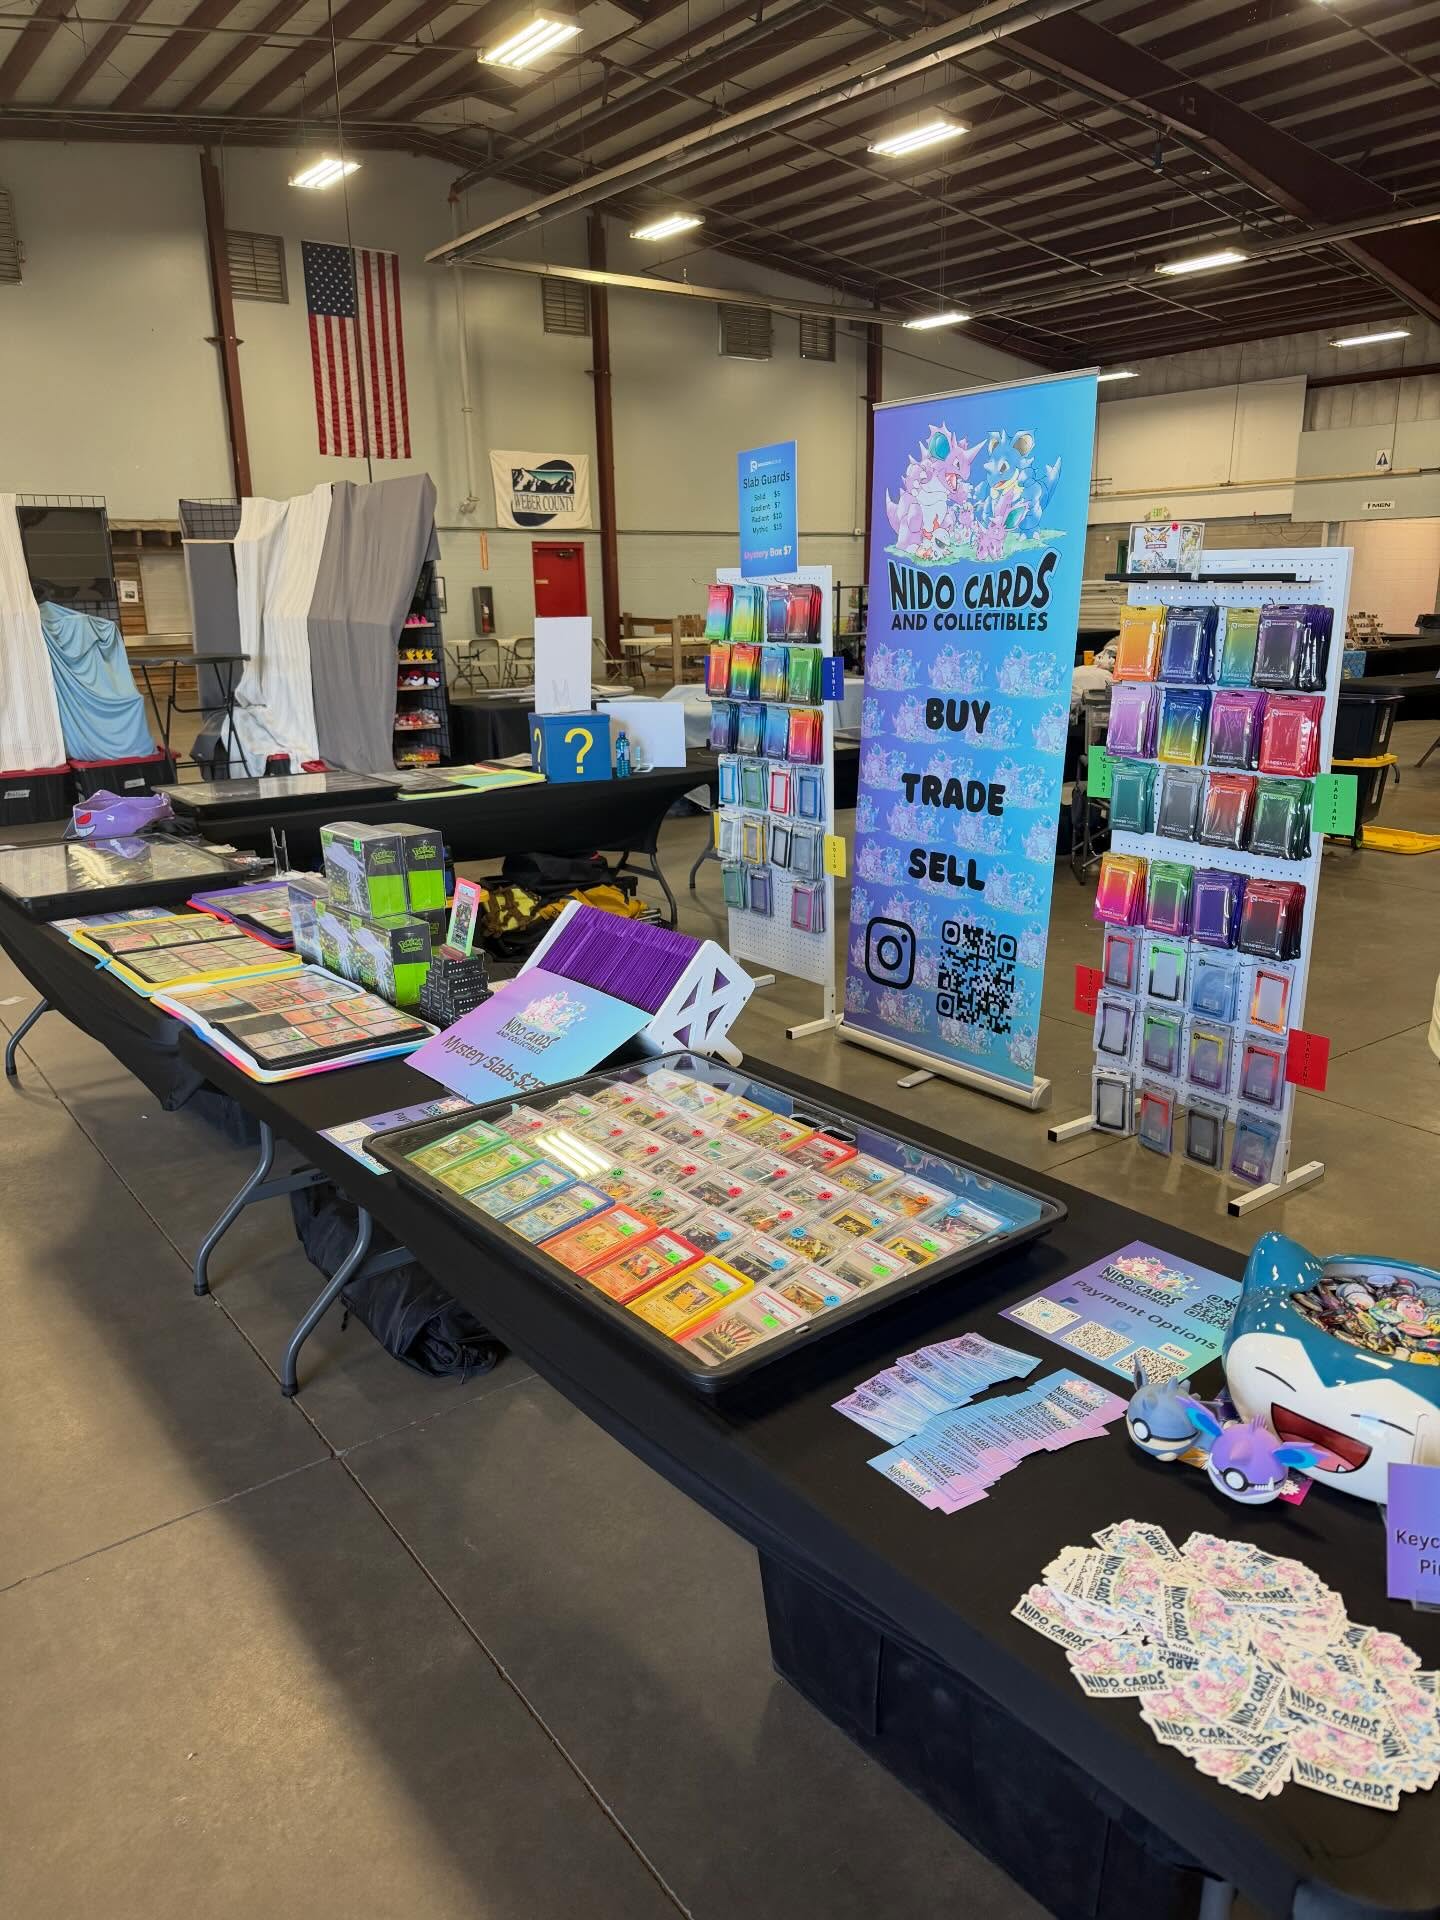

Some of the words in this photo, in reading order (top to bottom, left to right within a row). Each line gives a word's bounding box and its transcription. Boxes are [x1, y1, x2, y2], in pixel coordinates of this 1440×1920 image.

[743, 477, 759, 489] Slab
[761, 471, 790, 486] Guards
[514, 494, 541, 510] WEBER
[543, 495, 575, 511] COUNTY
[775, 501, 781, 509] $7
[744, 550, 768, 560] Mystery
[770, 547, 782, 556] Box
[783, 546, 792, 555] $7
[889, 561, 955, 610] NIDO
[964, 551, 1058, 610] CARDS
[891, 613, 927, 631] AND
[933, 612, 1048, 631] COLLECTIBLES
[925, 698, 990, 733] BUY
[901, 773, 1006, 816] TRADE
[908, 848, 985, 891] SELL
[502, 1017, 527, 1035] NIDO
[523, 1031, 560, 1049] CARDS
[441, 1035, 489, 1066] Mystery
[483, 1056, 519, 1081] Slabs
[1303, 1035, 1312, 1084] GRADIENT
[1097, 1274, 1115, 1284] AND
[1117, 1283, 1170, 1308] COLLECTIBLES
[1102, 1267, 1134, 1286] NIDO
[1136, 1285, 1184, 1305] CARDS
[1072, 1280, 1148, 1317] Payment
[1148, 1314, 1218, 1350] Options
[1164, 1345, 1185, 1357] Zelle
[1045, 1393, 1065, 1409] NIDO
[1064, 1402, 1089, 1420] CARDS
[888, 1464, 906, 1481] NIDO
[905, 1478, 931, 1496] CARDS
[1137, 1530, 1168, 1556] CARDS
[1103, 1554, 1126, 1576] NIDO
[1420, 1559, 1440, 1575] Pi
[1086, 1566, 1102, 1599] COLLECTIBLES
[1094, 1577, 1111, 1605] CARDS
[1171, 1585, 1189, 1610] NIDO
[1216, 1588, 1252, 1600] NIDO
[1255, 1587, 1295, 1600] CARDS
[1017, 1611, 1033, 1623] AND
[1034, 1621, 1082, 1651] COLLECTIBLES
[1020, 1601, 1049, 1625] NIDO
[1051, 1624, 1094, 1648] CARDS
[1164, 1599, 1175, 1639] COLLECTIBLES
[1172, 1611, 1195, 1645] CARDS
[1081, 1673, 1120, 1688] NIDO
[1123, 1669, 1167, 1688] CARDS
[1112, 1685, 1169, 1694] COLLECTIBLES
[1228, 1702, 1257, 1728] NIDO
[1251, 1665, 1274, 1702] CARDS
[1251, 1714, 1262, 1731] AND
[1260, 1676, 1283, 1716] COLLECTIBLES
[1290, 1686, 1327, 1714] NIDO
[1332, 1709, 1382, 1734] CARDS
[1154, 1718, 1194, 1737] NIDO
[1291, 1702, 1312, 1715] AND
[1315, 1711, 1379, 1740] COLLECTIBLES
[1162, 1734, 1183, 1742] AND
[1232, 1765, 1265, 1790] NIDO
[1295, 1758, 1337, 1785] NIDO
[1343, 1777, 1395, 1800] CARDS
[1300, 1776, 1323, 1787] AND
[1326, 1783, 1393, 1806] COLLECTIBLES
